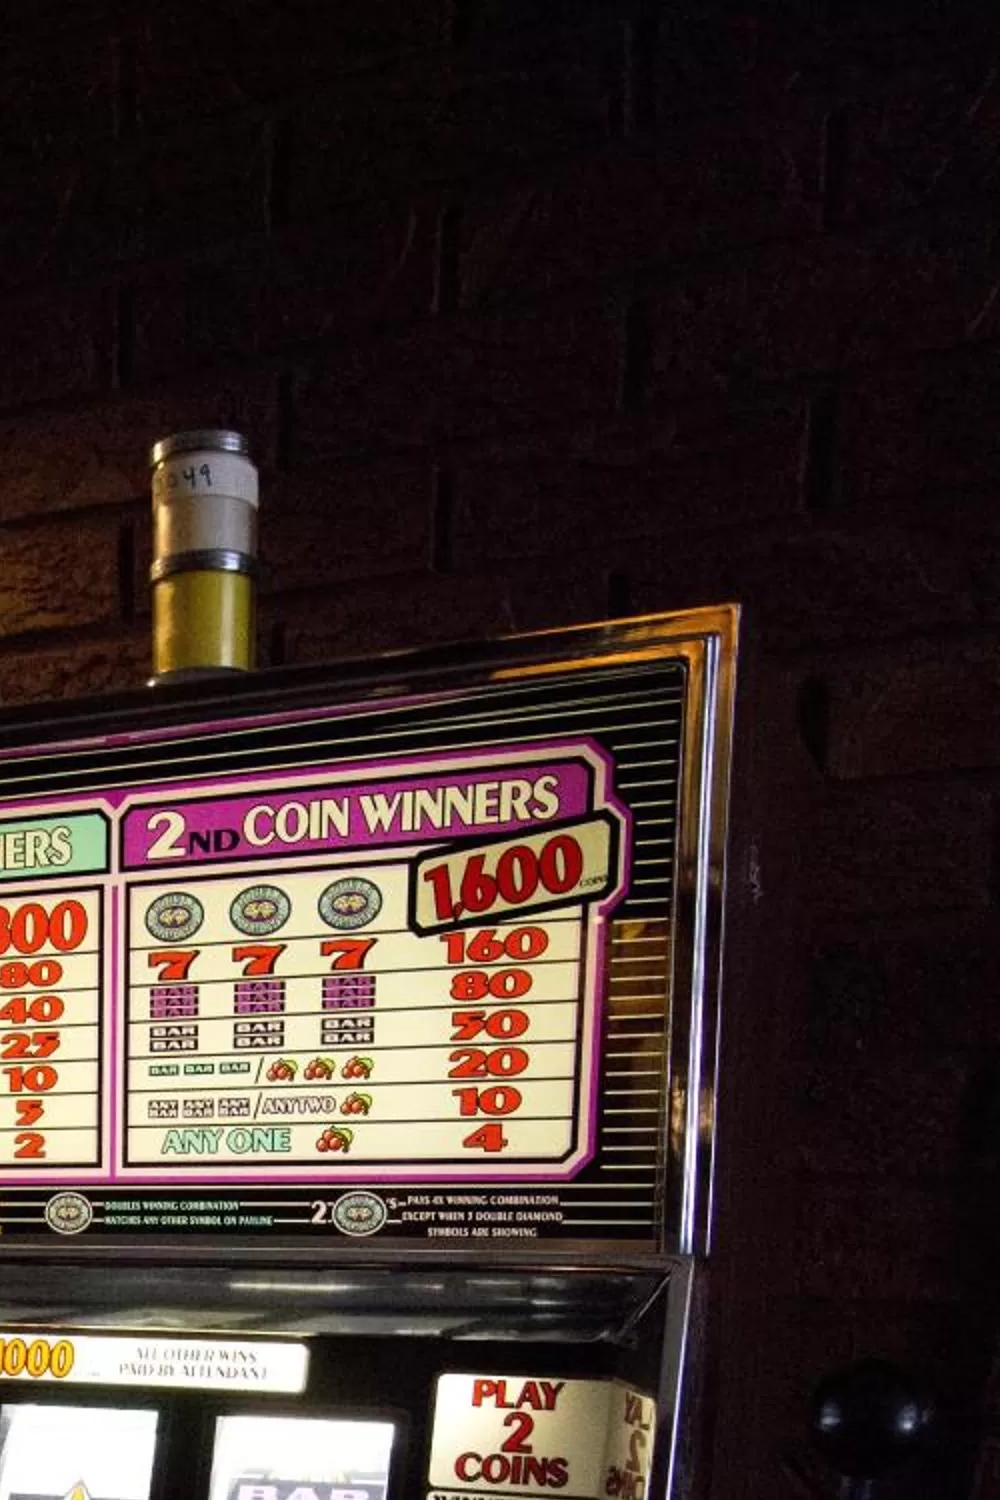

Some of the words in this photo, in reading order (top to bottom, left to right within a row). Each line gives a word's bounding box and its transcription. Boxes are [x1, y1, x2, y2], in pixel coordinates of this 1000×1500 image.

[243, 798, 350, 848] COIN
[360, 775, 560, 835] WINNERS
[424, 834, 584, 921] 1,600
[148, 950, 199, 981] 7
[232, 944, 287, 976] 7
[320, 938, 377, 970] 7
[440, 926, 549, 964] 160
[450, 968, 533, 1001] 80
[152, 1027, 195, 1036] BAR
[236, 1023, 282, 1032] BAR
[324, 1019, 372, 1028] BAR
[450, 1009, 530, 1041] 50
[0, 1032, 61, 1059] 25
[152, 1040, 195, 1049] BAR
[236, 1036, 282, 1046] BAR
[324, 1033, 372, 1042] BAR
[151, 1066, 178, 1075] BAR
[185, 1064, 213, 1073] BAR
[221, 1063, 249, 1072] BAR
[448, 1047, 529, 1078] 20
[2, 1065, 59, 1092] 10
[16, 1100, 44, 1126] 5
[451, 1086, 523, 1116] 10
[14, 1132, 46, 1158] 2
[161, 1129, 225, 1154] ANY
[225, 1128, 292, 1154] ONE
[462, 1123, 508, 1152] 4
[312, 1201, 328, 1224] 2
[490, 1195, 559, 1205] COMBINATION
[401, 1212, 435, 1221] EXCEPT
[475, 1212, 514, 1221] DOUBLE
[515, 1212, 563, 1221] DIAMOND
[163, 1348, 214, 1362] OTHER
[219, 1349, 257, 1363] WINS
[181, 1364, 268, 1380] ATTENDANT
[472, 1379, 567, 1410] PLAY
[501, 1411, 534, 1454] 2
[454, 1451, 569, 1488] COINS
